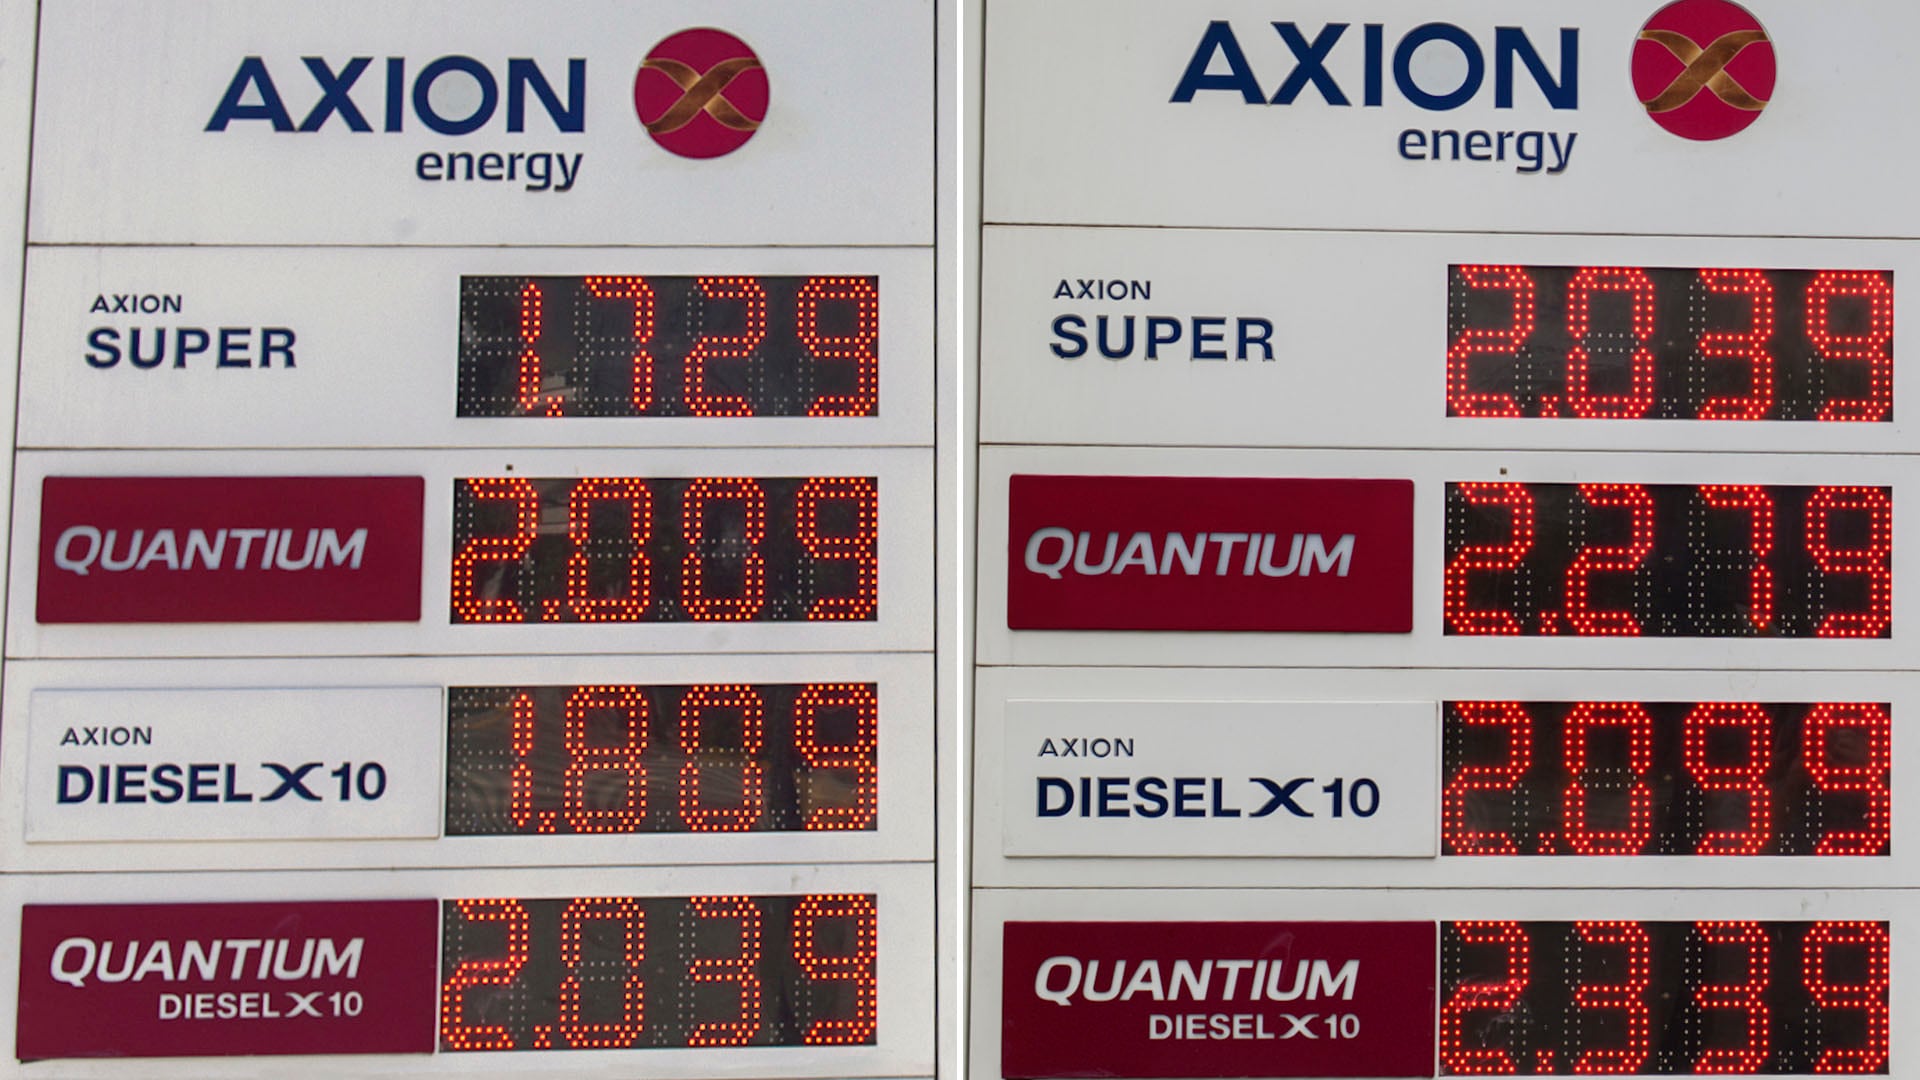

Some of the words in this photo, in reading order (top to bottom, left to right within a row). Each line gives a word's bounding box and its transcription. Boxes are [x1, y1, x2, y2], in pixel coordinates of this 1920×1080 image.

[1170, 20, 1580, 111] AXION
[205, 55, 586, 135] AXION
[415, 151, 583, 193] energy
[1397, 125, 1578, 174] energy
[90, 295, 183, 313] AXION
[1053, 279, 1152, 301] AXION
[84, 328, 297, 369] SUPER
[519, 276, 878, 417] 1.729
[1049, 315, 1276, 363] SUPER
[1446, 264, 1893, 422] 2.039
[54, 527, 367, 575] QUANTIUM
[452, 477, 878, 621] 2.009
[1024, 527, 1356, 579] QUANTIUM
[1443, 481, 1892, 637] 2.279
[60, 727, 153, 746] AXION
[510, 683, 878, 833] 1.809
[1037, 737, 1135, 758] AXION
[1442, 701, 1890, 855] 2.099
[50, 937, 365, 984] QUANTIUM
[440, 895, 878, 1050] 2.039
[1034, 957, 1360, 1003] QUANTIUM
[1440, 920, 1889, 1074] 2.339
